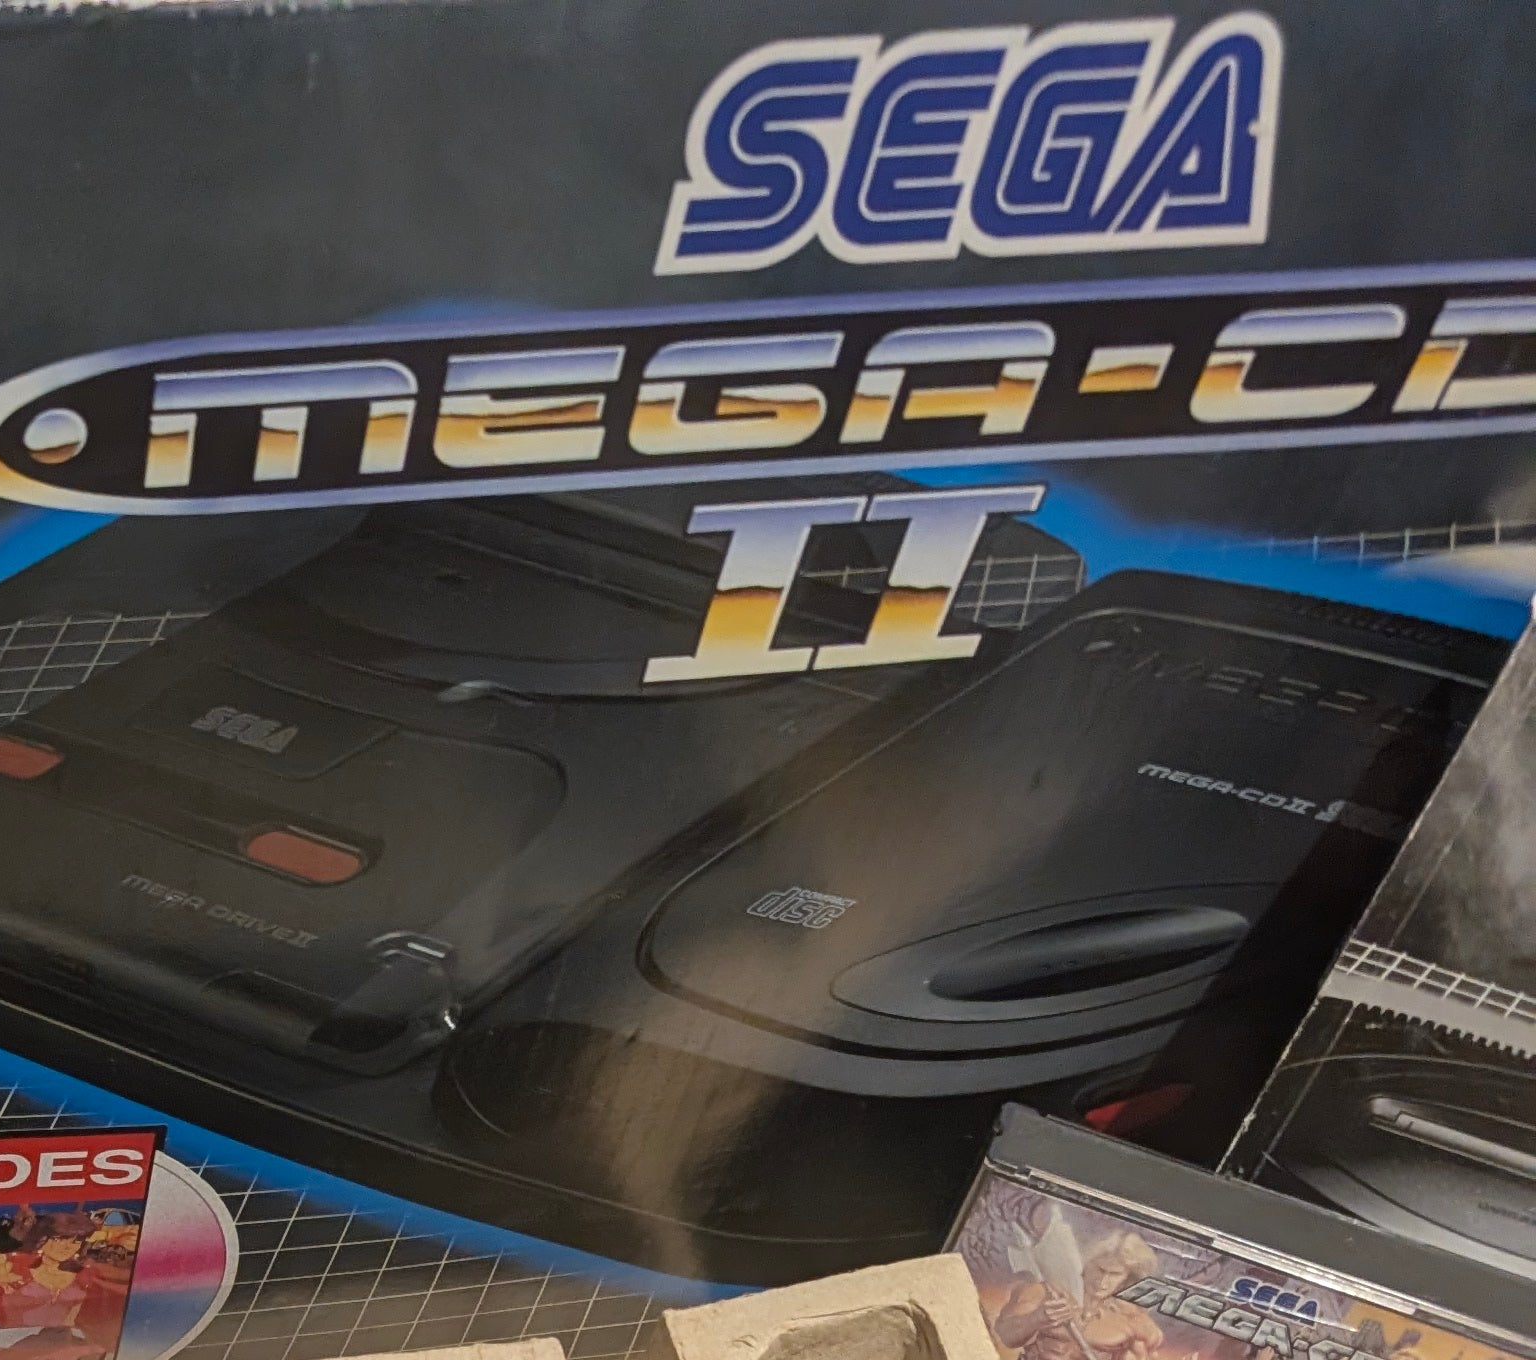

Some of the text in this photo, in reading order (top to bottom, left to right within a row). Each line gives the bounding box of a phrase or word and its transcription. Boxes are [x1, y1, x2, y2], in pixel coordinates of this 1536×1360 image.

[655, 11, 1282, 275] SEGA
[644, 484, 1044, 683] II
[191, 706, 299, 754] SEGA
[1230, 1277, 1320, 1328] SEGA
